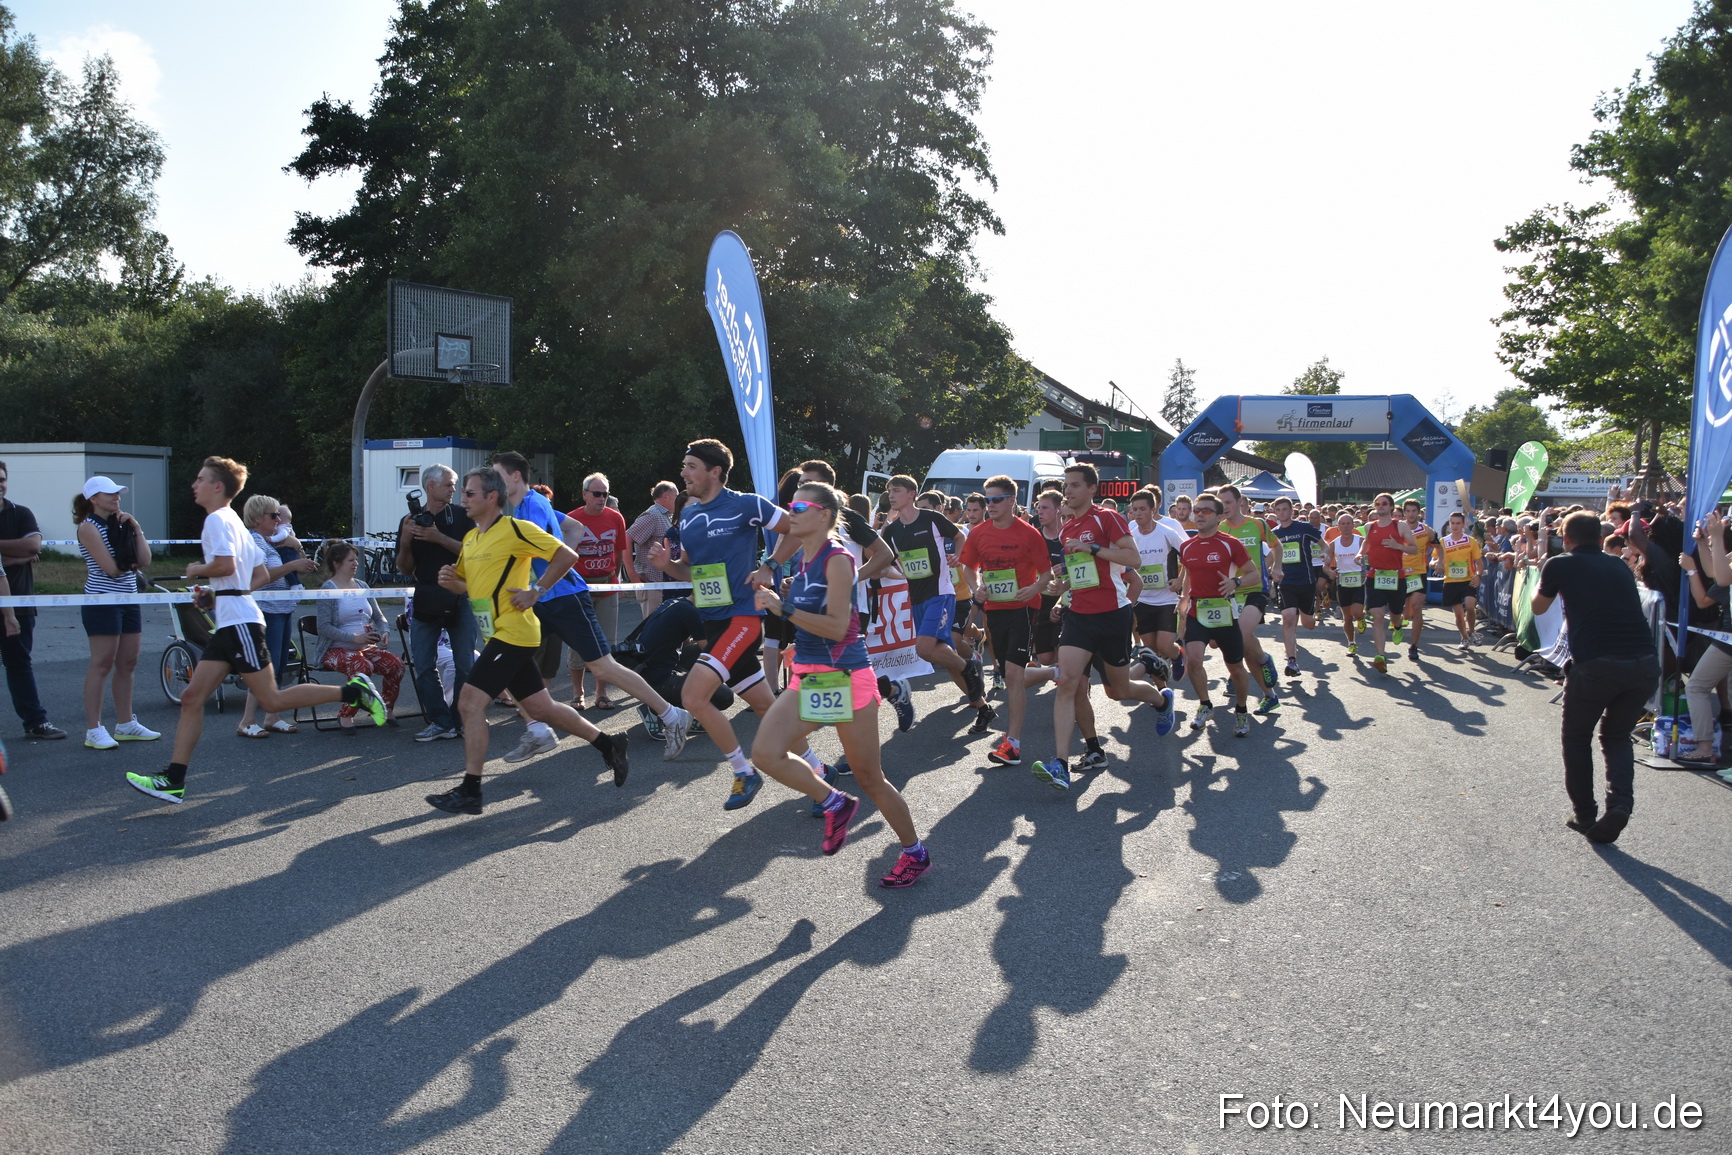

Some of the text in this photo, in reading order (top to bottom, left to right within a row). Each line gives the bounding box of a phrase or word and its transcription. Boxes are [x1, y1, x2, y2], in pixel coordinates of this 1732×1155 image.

[1297, 417, 1354, 428] firmenlauf
[1193, 435, 1223, 443] Fischer
[1283, 550, 1297, 559] 380
[904, 560, 928, 572] 1075
[1074, 566, 1086, 580] 27
[1377, 577, 1396, 585] 1364
[699, 581, 722, 596] 958
[988, 581, 1014, 594] 1527
[1207, 609, 1222, 620] 28
[810, 691, 843, 709] 952
